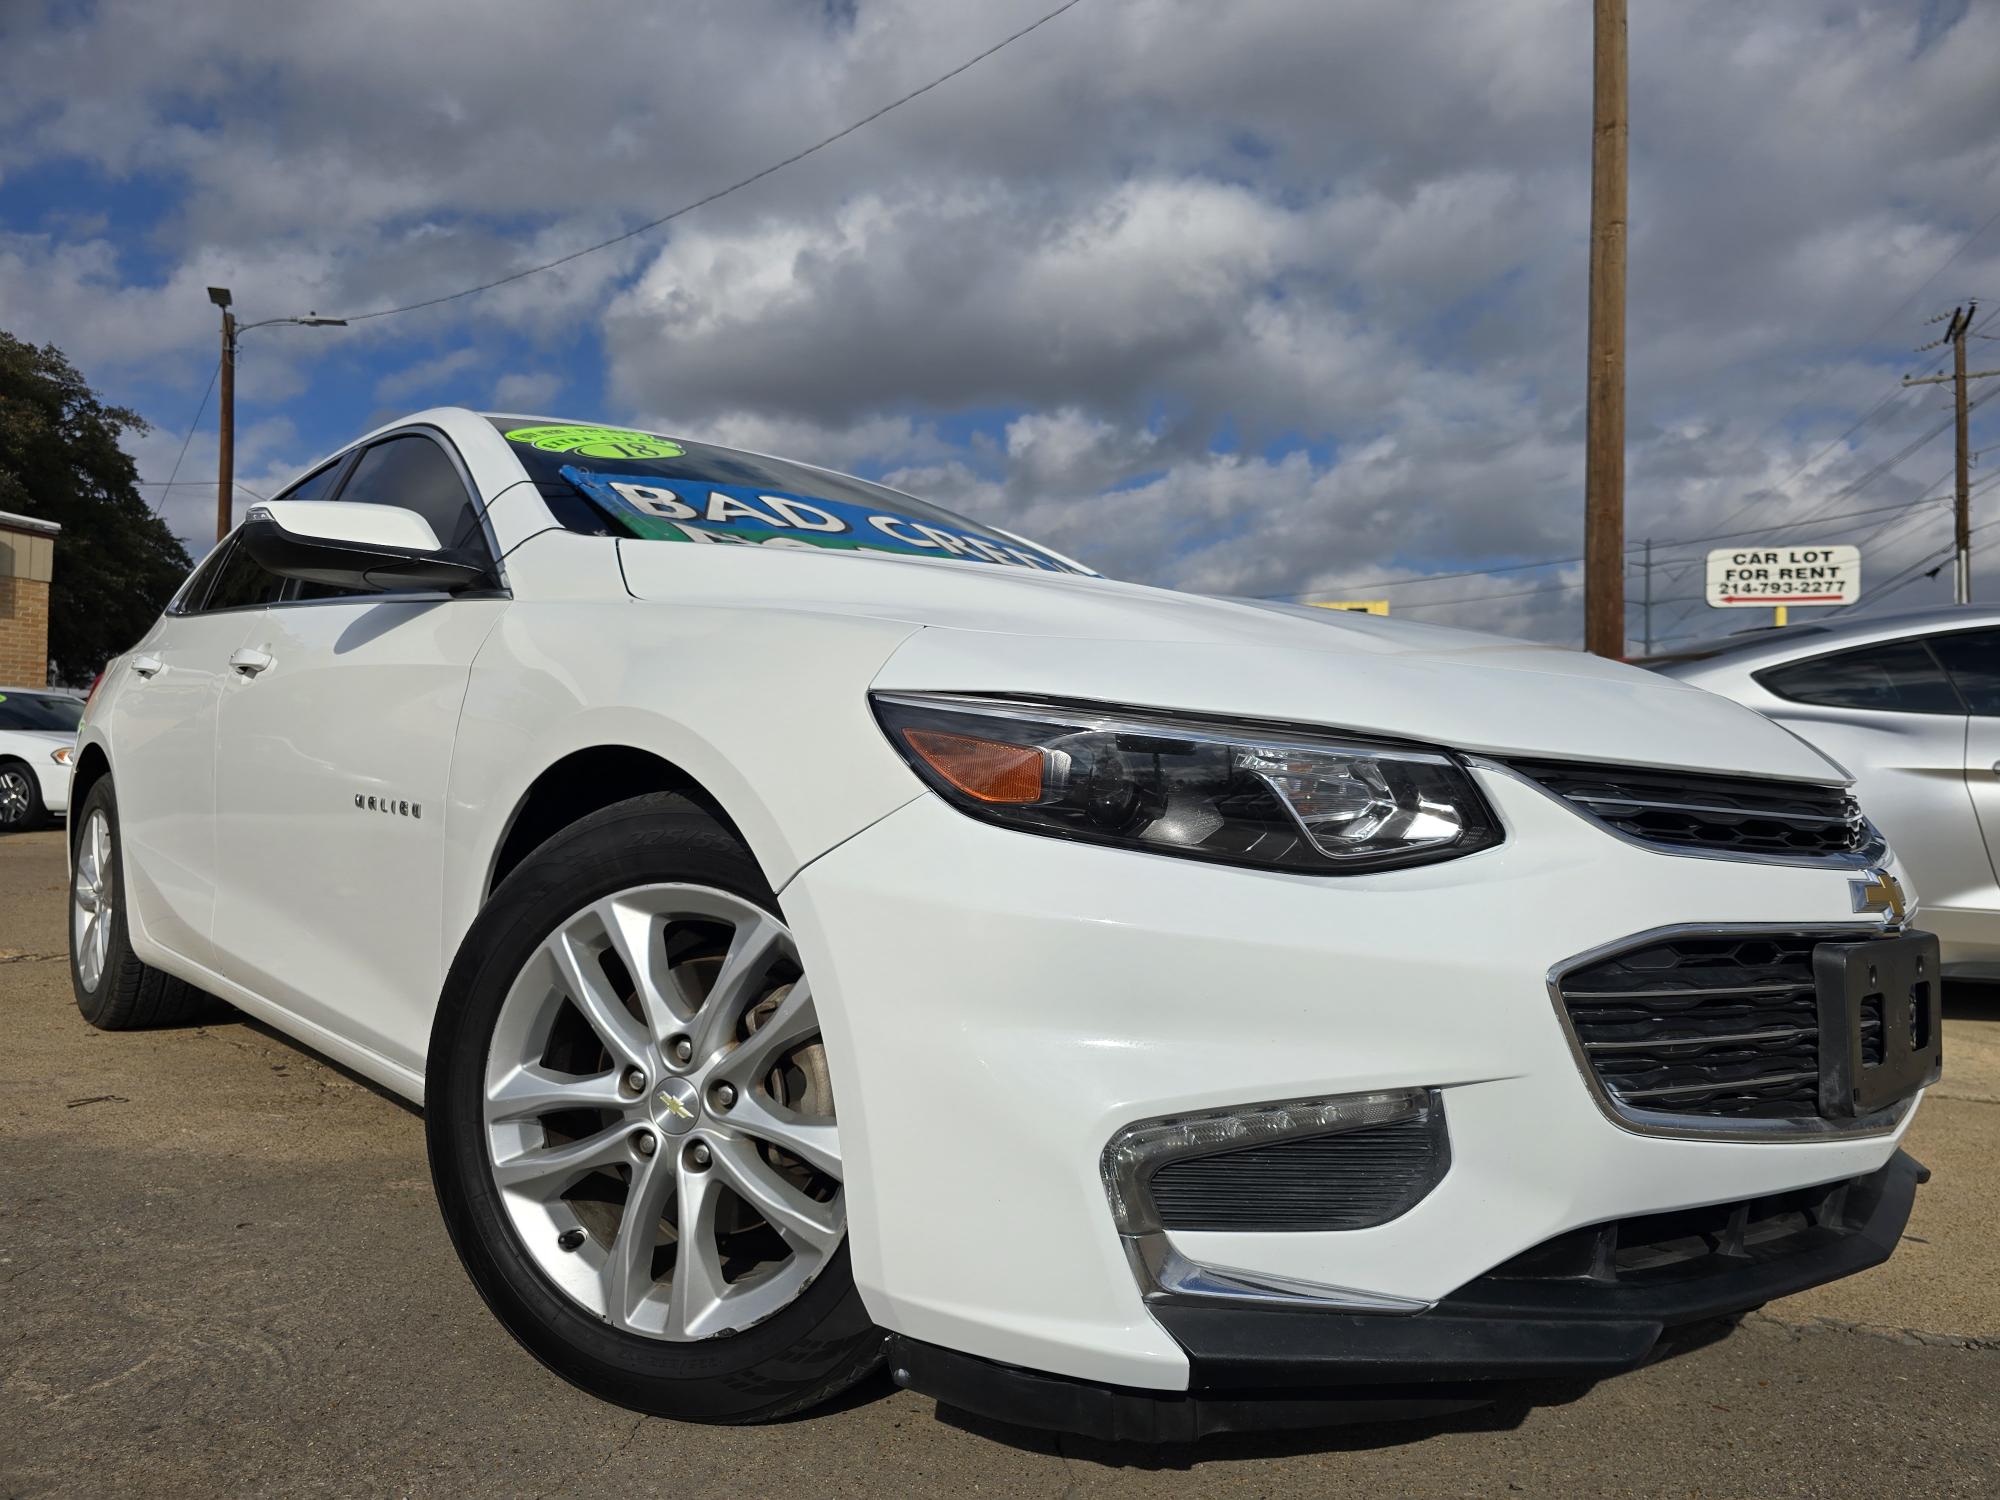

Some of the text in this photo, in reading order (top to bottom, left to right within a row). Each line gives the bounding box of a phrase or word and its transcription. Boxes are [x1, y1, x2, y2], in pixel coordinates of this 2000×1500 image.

[607, 443, 660, 458] 18
[608, 482, 846, 532] BAD
[868, 516, 1080, 576] CRED
[1732, 551, 1834, 566] CAR LOT
[1725, 566, 1841, 581] FOR RENT
[1718, 581, 1846, 595] 214-793-2277
[355, 793, 422, 819] MALIBU
